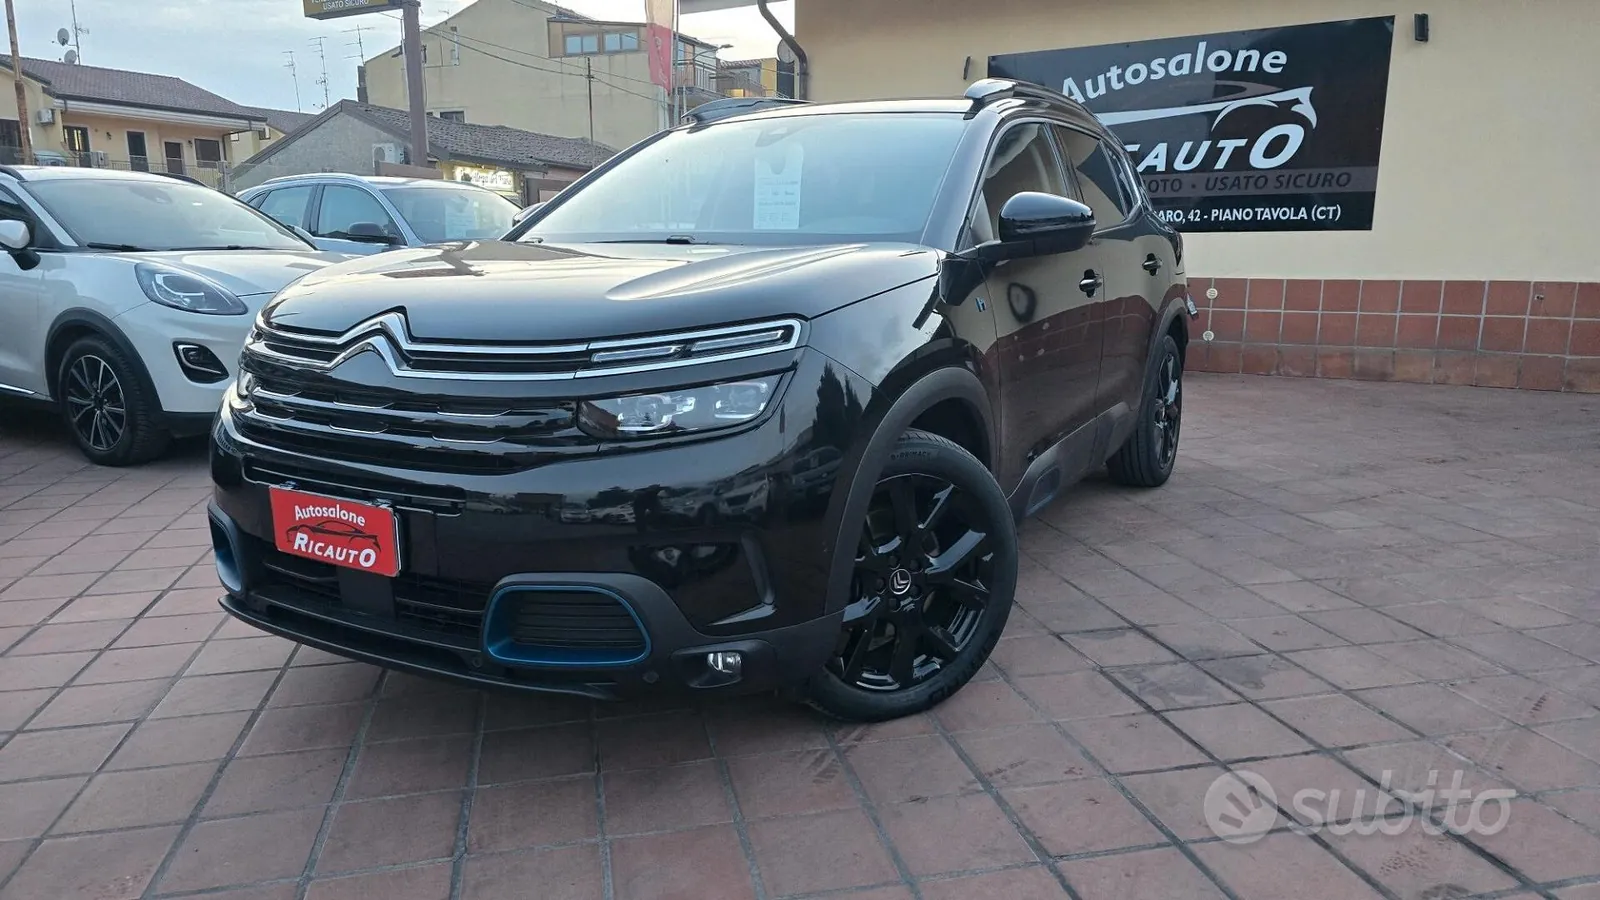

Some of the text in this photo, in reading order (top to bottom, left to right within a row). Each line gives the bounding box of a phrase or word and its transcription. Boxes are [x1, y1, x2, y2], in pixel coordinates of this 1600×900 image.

[323, 2, 343, 10] USATO
[1062, 41, 1288, 104] Autosalone
[1124, 123, 1305, 172] AUTO
[1144, 172, 1352, 193] OTO USATO SICURO
[1188, 209, 1200, 221] 42
[1211, 208, 1251, 221] PIANO
[1254, 206, 1308, 221] TAVOLA
[1311, 204, 1342, 222] (CT)
[294, 504, 366, 526] Autosalone
[293, 532, 376, 568] RICAUTO
